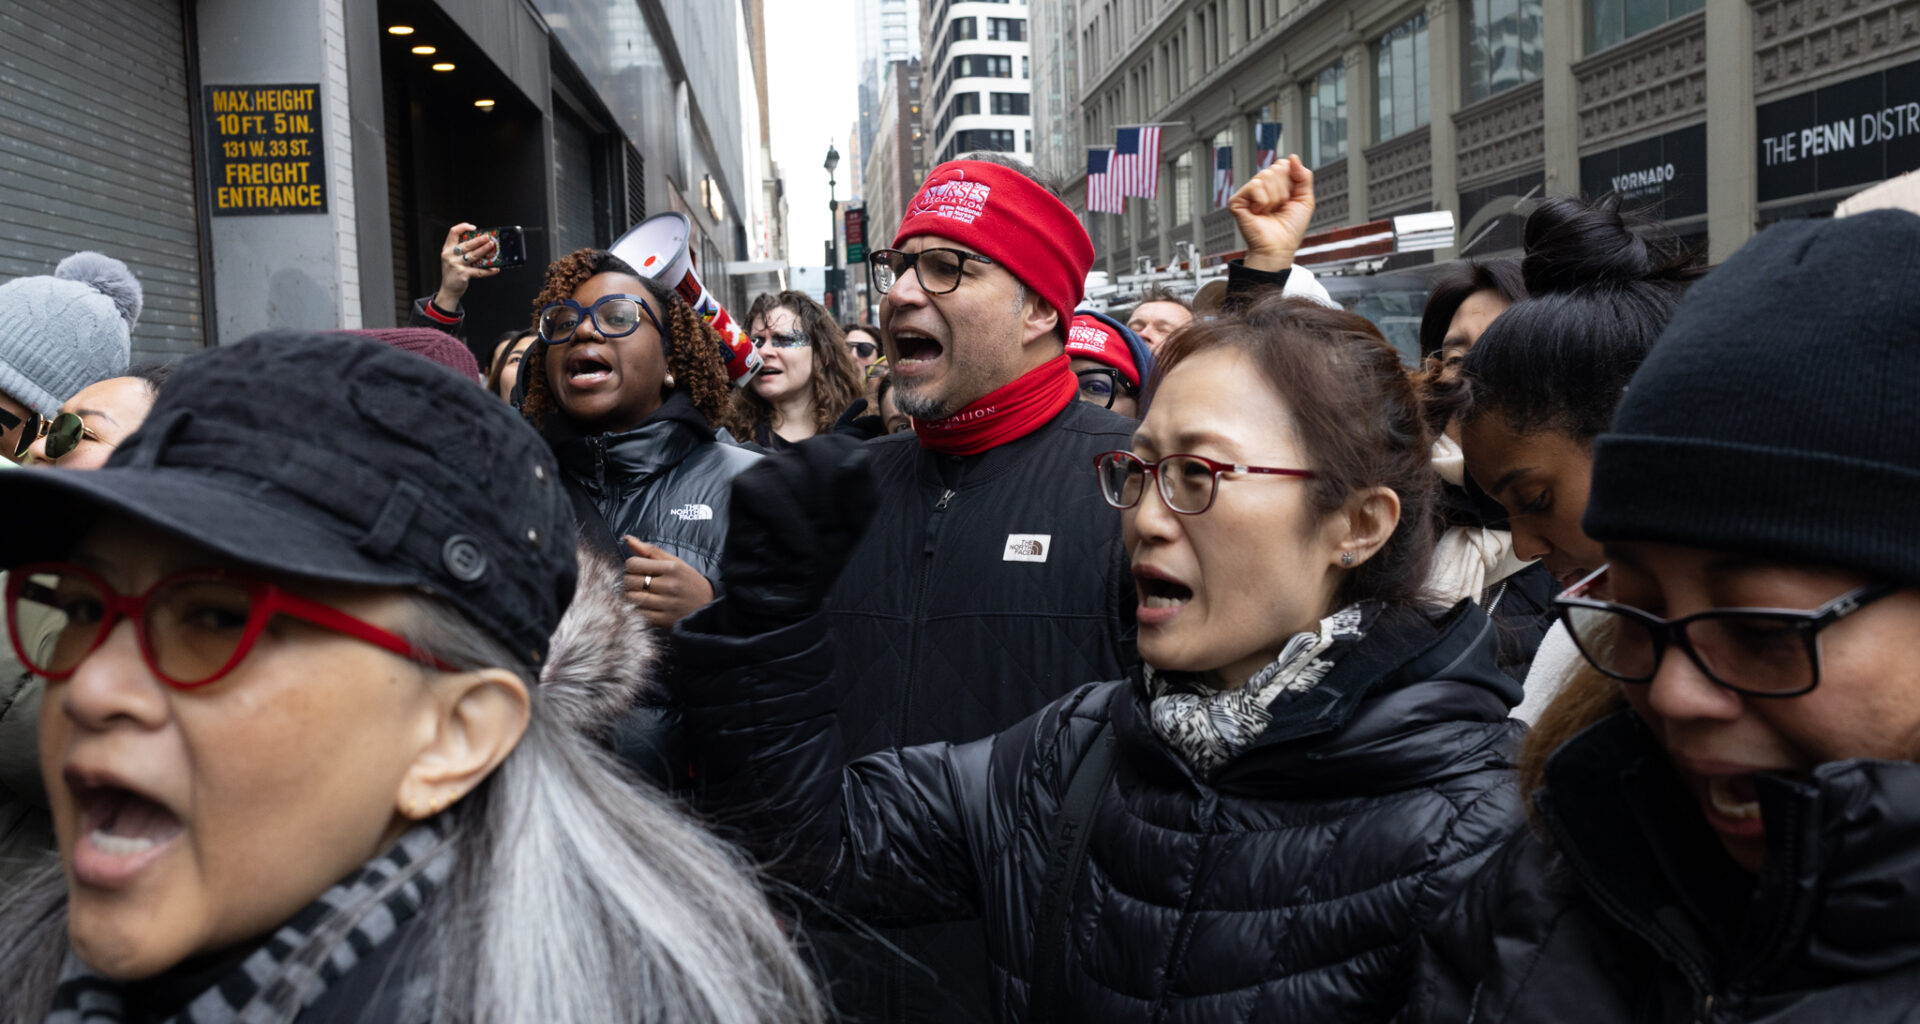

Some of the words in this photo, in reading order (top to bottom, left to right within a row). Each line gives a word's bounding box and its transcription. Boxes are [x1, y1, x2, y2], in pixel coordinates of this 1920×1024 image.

[213, 90, 254, 112] MAX.
[255, 89, 315, 111] HEIGHT
[1763, 132, 1796, 166] THE
[1801, 118, 1855, 158] PENN
[1861, 102, 1920, 146] DISTR
[222, 141, 246, 158] 131
[249, 141, 268, 157] W.
[270, 140, 287, 157] 33
[290, 139, 312, 156] ST.
[225, 162, 310, 185] FREIGHT
[1612, 163, 1675, 192] VORNADO
[217, 185, 322, 208] ENTRANCE
